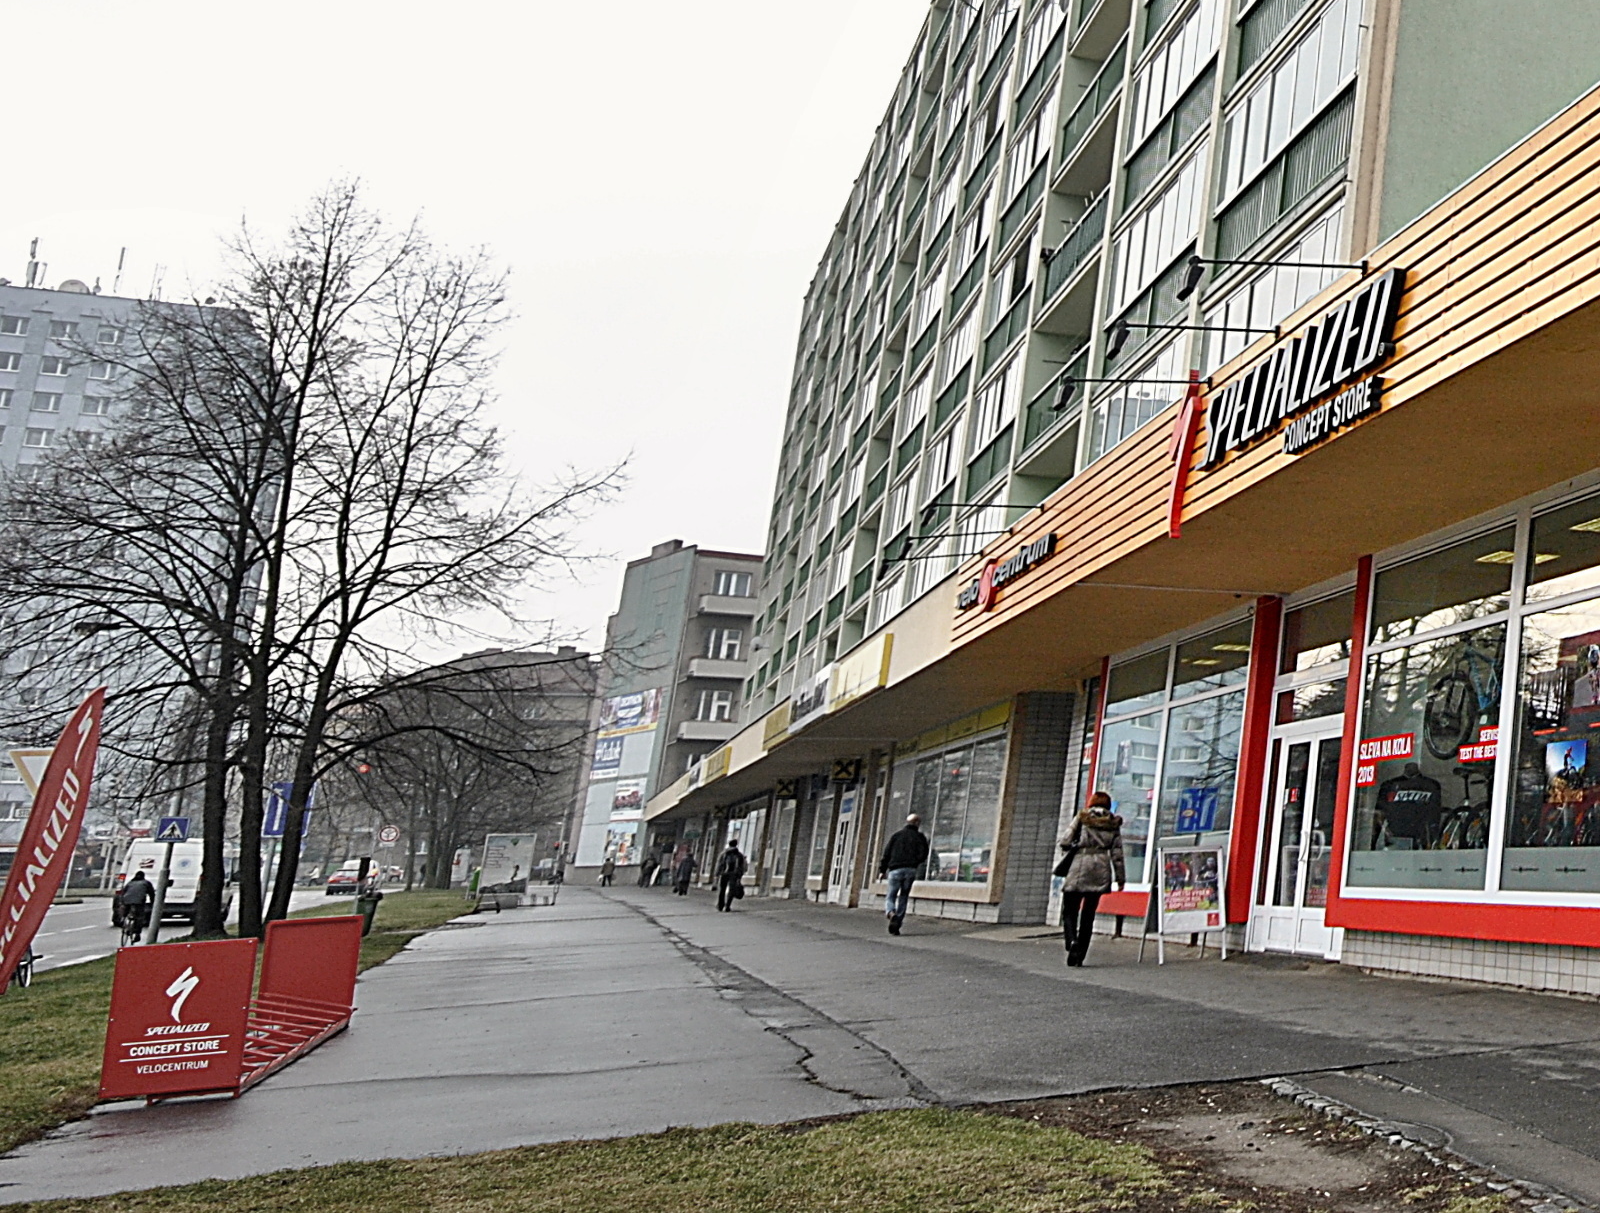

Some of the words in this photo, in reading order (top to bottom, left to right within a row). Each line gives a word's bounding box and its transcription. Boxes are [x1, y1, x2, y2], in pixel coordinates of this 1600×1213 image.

[1195, 268, 1402, 471] SPECIALIZED
[1281, 399, 1333, 455] CONCEPT
[1331, 376, 1376, 433] STORE
[992, 533, 1054, 588] centrum
[1359, 740, 1381, 761] SLEVA
[1381, 740, 1391, 757] NA
[1391, 736, 1412, 756] KOLA
[1459, 746, 1473, 761] TEST
[1356, 764, 1375, 784] 2013
[143, 1022, 211, 1037] SPECIALIZED
[129, 1043, 182, 1057] CONCEPT
[183, 1039, 220, 1052] STORE
[136, 1059, 209, 1075] VELOCENTRUM
